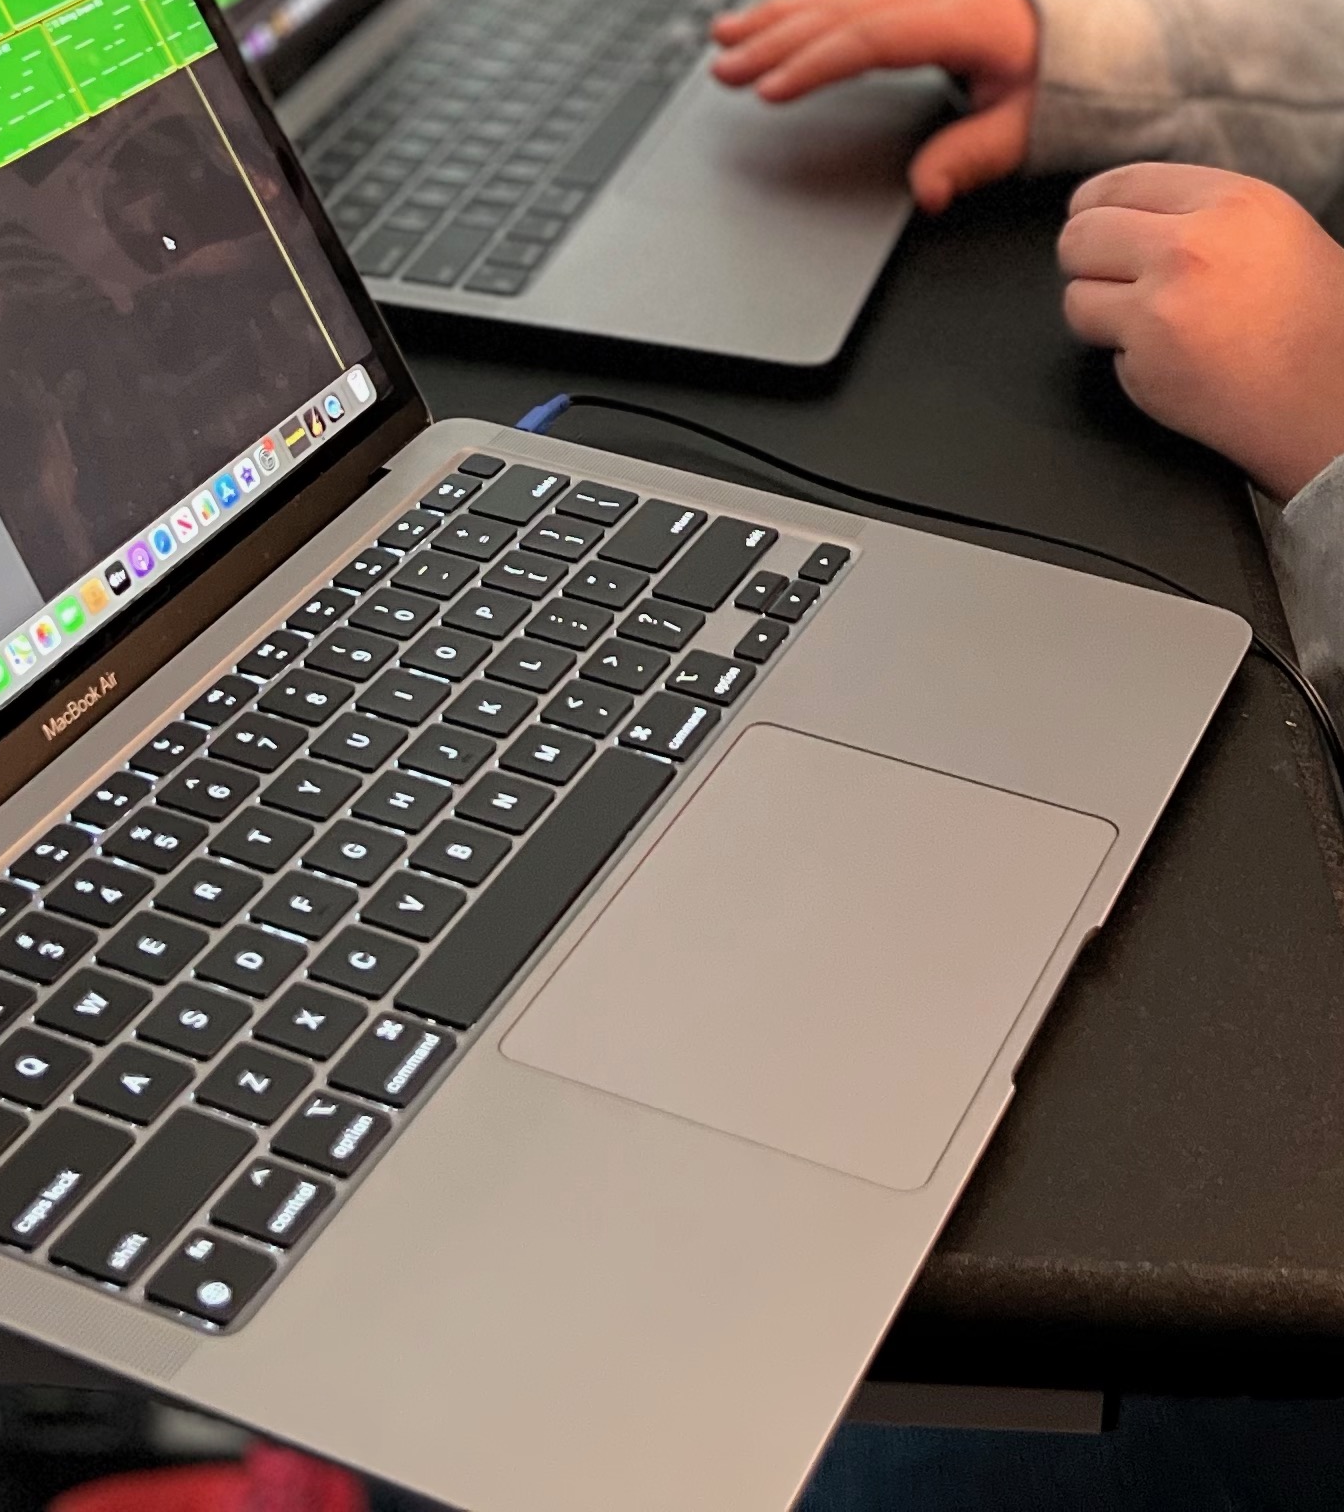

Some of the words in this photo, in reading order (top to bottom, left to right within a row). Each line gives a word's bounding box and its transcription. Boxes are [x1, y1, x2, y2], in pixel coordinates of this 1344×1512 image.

[393, 609, 415, 621] 0
[475, 606, 494, 619] P
[351, 650, 372, 662] 9
[435, 646, 457, 659] O
[519, 660, 542, 671] L
[42, 686, 102, 742] MacBook
[98, 671, 118, 696] Air
[305, 692, 328, 705] 8
[477, 700, 502, 715] K
[668, 706, 707, 750] command
[257, 737, 278, 750] 7
[346, 732, 370, 748] U
[439, 745, 458, 759] J
[534, 744, 561, 762] M
[207, 785, 231, 799] 6
[297, 780, 322, 794] Y
[389, 792, 415, 809] H
[491, 792, 518, 810] N
[153, 834, 178, 849] 5
[247, 829, 272, 844] T
[341, 843, 367, 859] G
[445, 843, 473, 860] B
[100, 887, 123, 903] 4
[193, 883, 222, 900] R
[290, 895, 313, 913] F
[398, 894, 425, 911] V
[38, 942, 65, 959] 3
[138, 937, 167, 955] E
[235, 951, 264, 970] D
[348, 952, 377, 970] C
[75, 992, 109, 1015] W
[179, 1010, 209, 1029] S
[295, 1008, 326, 1030] X
[15, 1057, 49, 1076] Q
[385, 1032, 441, 1094] command
[121, 1075, 151, 1094] A
[238, 1070, 270, 1093] Z
[331, 1115, 373, 1159] option
[13, 1199, 53, 1234] caps
[41, 1170, 80, 1202] lock
[269, 1181, 317, 1233] control
[109, 1233, 149, 1270] shift
[185, 1239, 214, 1260] fn
